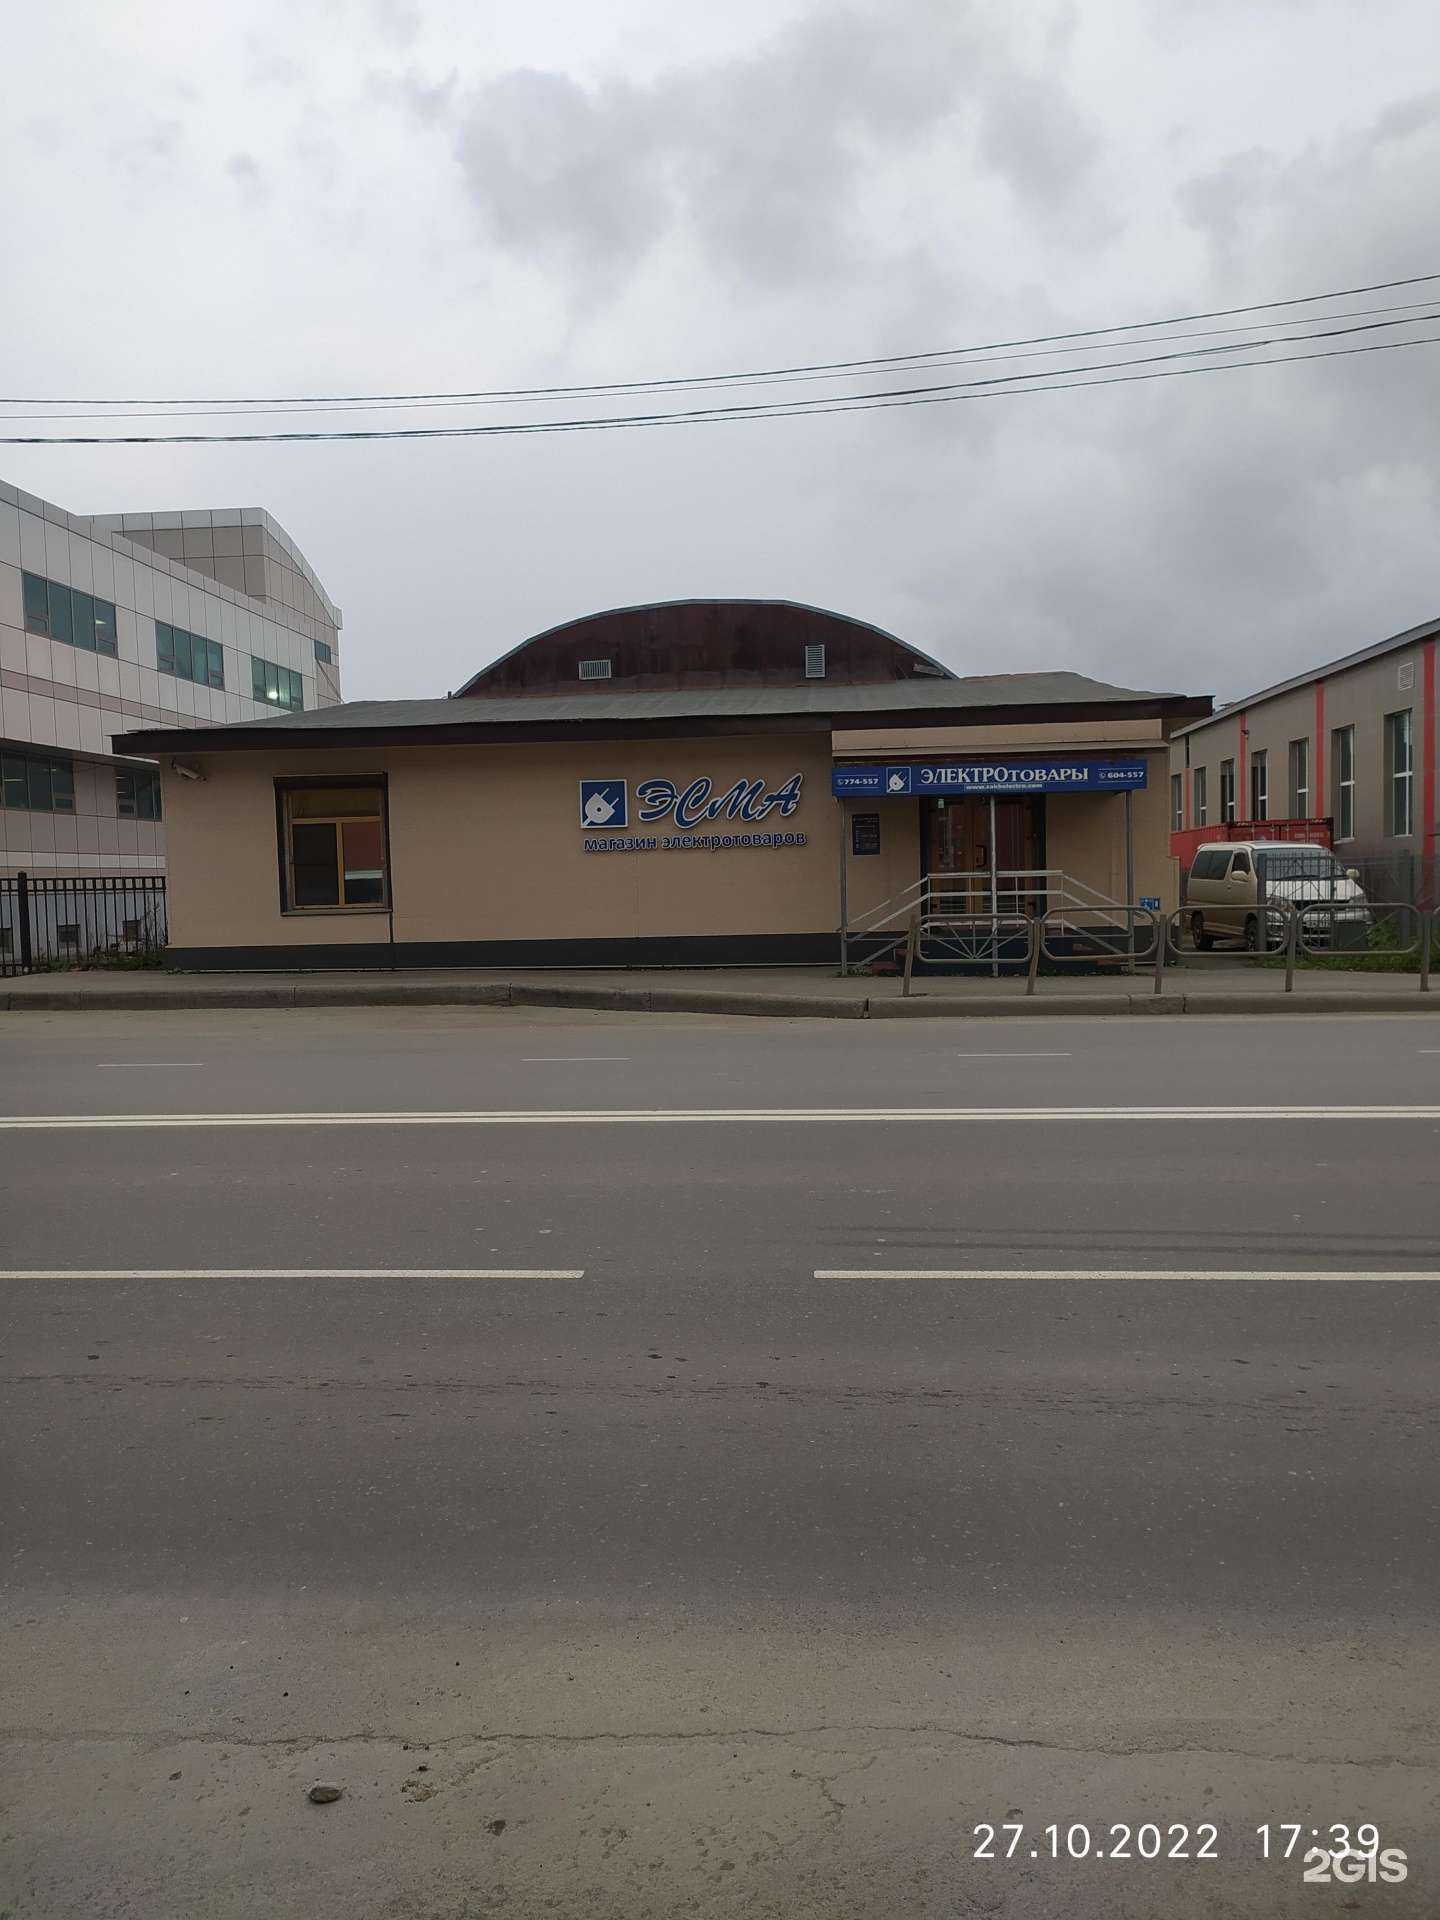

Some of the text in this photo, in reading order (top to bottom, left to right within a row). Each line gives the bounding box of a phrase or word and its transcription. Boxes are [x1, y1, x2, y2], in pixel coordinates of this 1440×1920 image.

[1107, 771, 1144, 779] 604-557
[636, 773, 803, 829] ЭСМА
[584, 832, 807, 852] магазин электротоваров
